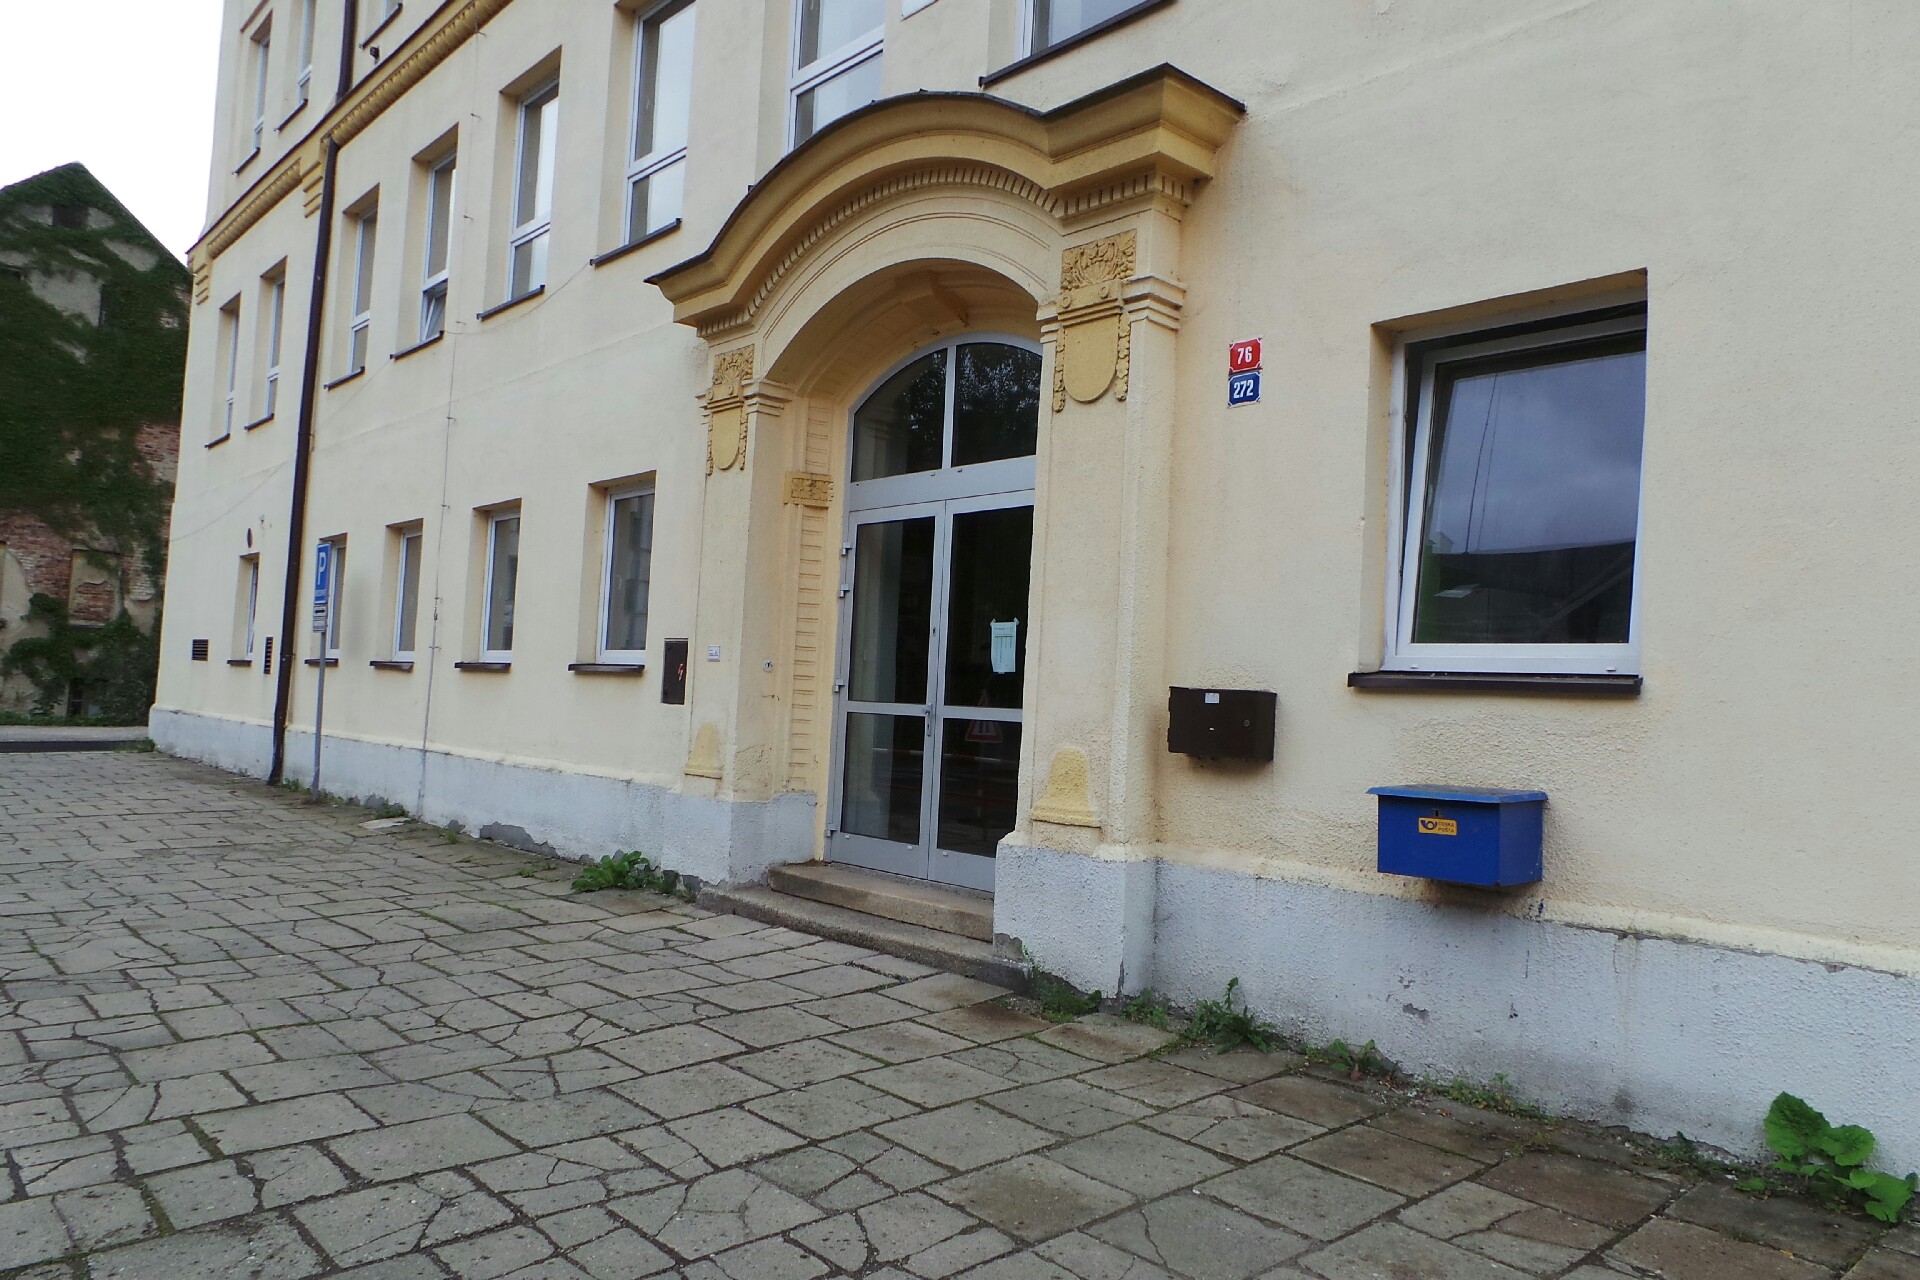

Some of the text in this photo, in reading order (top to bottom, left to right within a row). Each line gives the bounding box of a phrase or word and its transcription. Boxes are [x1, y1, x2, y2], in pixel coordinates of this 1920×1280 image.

[1237, 346, 1253, 365] 76
[1233, 379, 1254, 399] 272
[317, 551, 327, 586] P
